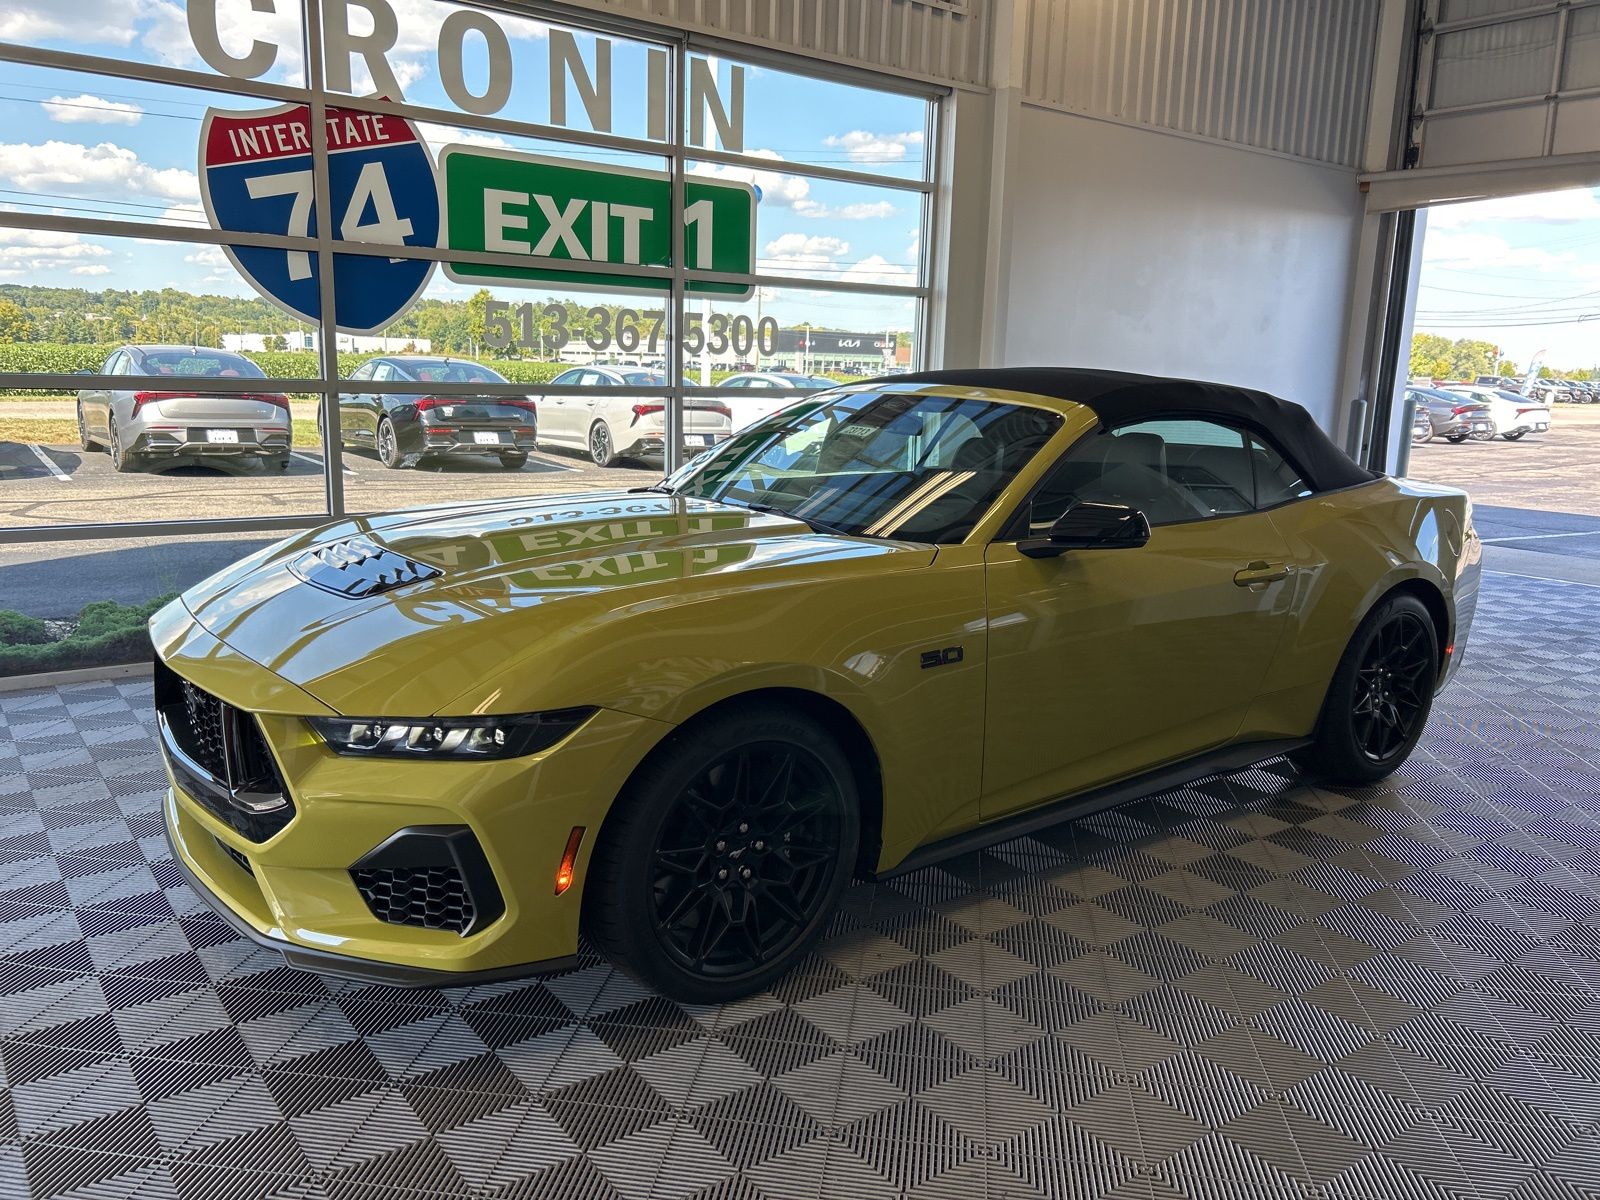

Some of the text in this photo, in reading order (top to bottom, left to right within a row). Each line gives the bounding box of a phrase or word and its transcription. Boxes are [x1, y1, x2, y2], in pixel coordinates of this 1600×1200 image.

[187, 0, 745, 153] CRONIN
[228, 114, 390, 158] INTERTATE
[245, 161, 414, 282] 74
[484, 187, 714, 270] EXIT 1
[482, 300, 779, 357] 513-3675300
